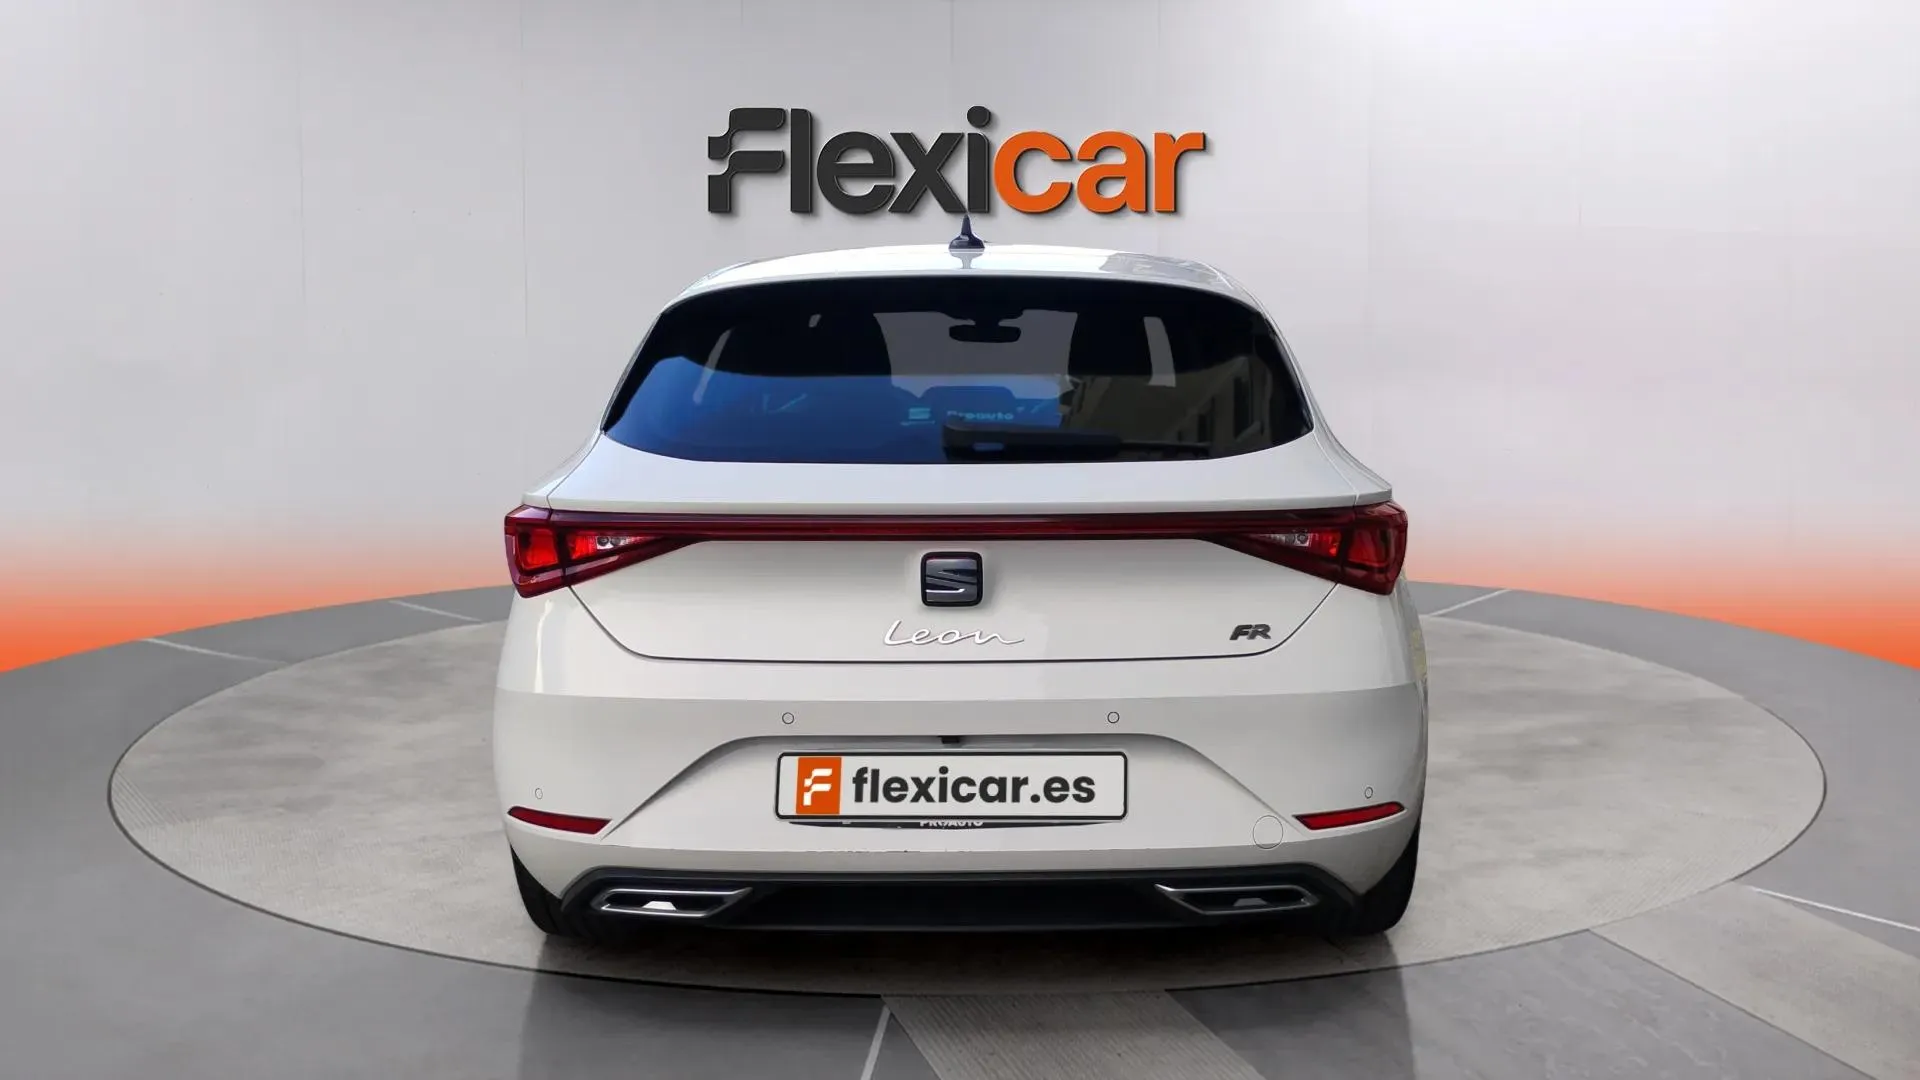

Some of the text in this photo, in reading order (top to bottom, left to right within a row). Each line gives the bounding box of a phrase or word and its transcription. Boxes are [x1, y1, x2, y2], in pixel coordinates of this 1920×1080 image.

[708, 105, 1207, 213] Flexicar
[883, 620, 1025, 646] Leon
[1229, 623, 1272, 641] FR
[852, 766, 1096, 803] flexicar.es
